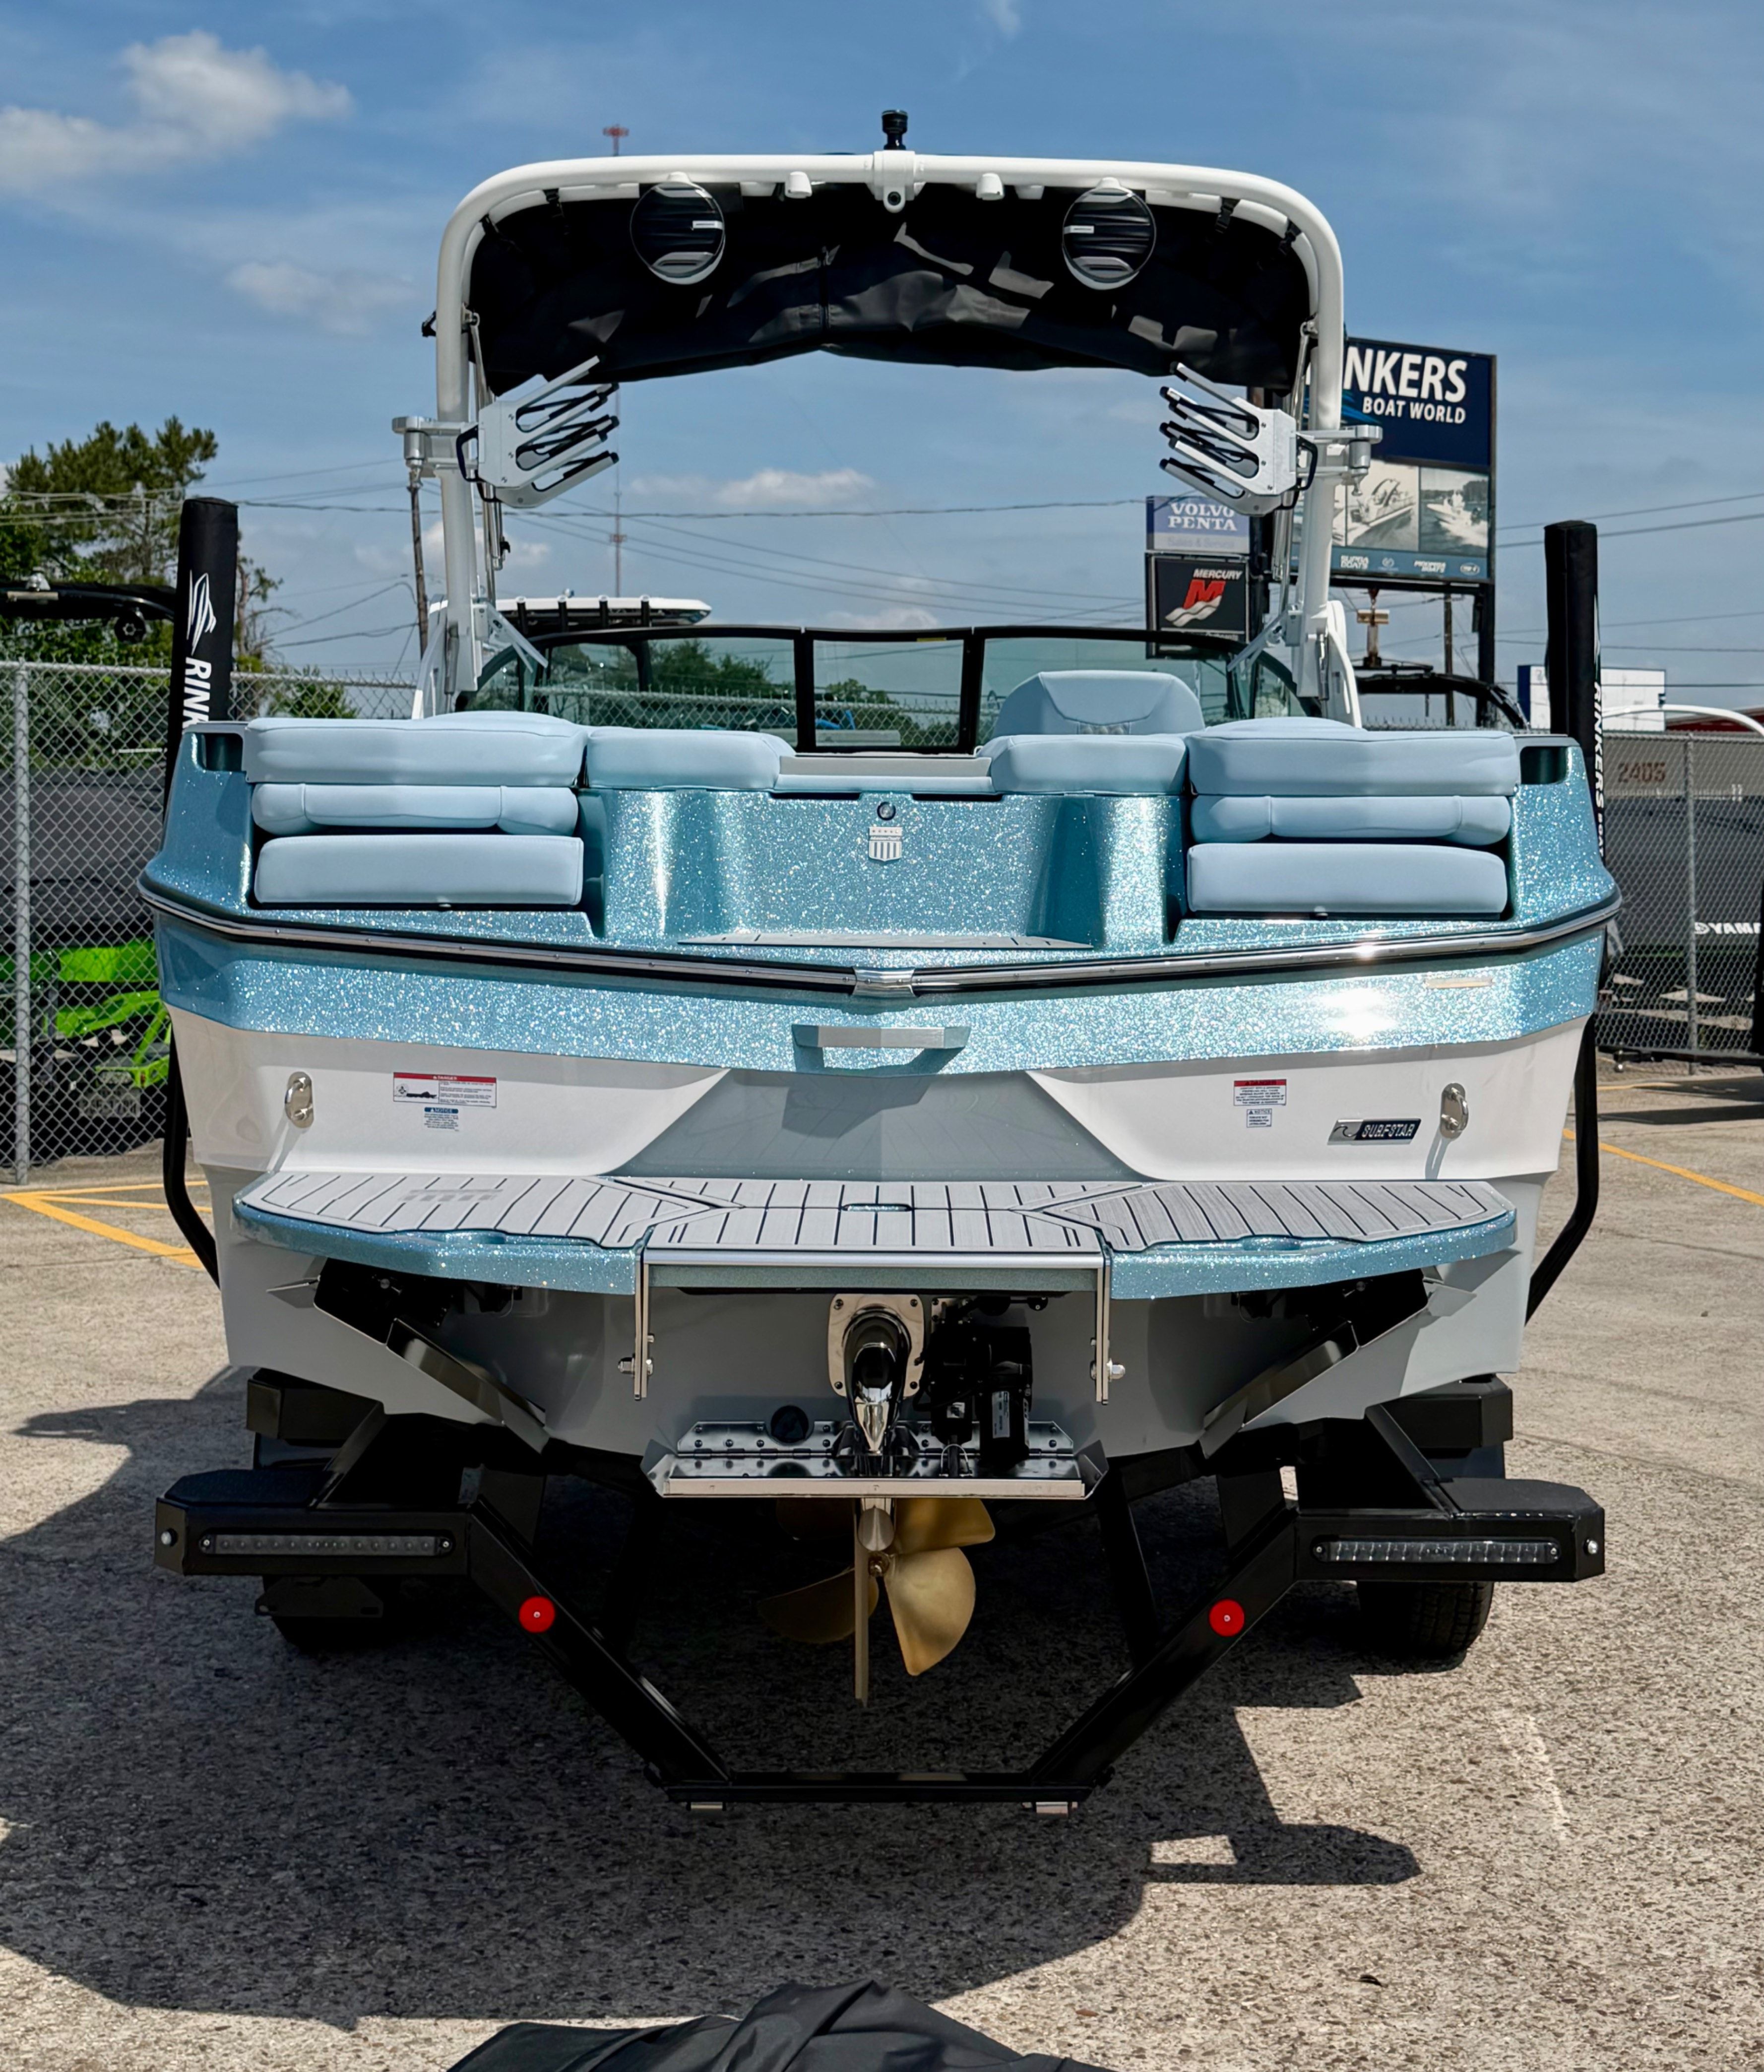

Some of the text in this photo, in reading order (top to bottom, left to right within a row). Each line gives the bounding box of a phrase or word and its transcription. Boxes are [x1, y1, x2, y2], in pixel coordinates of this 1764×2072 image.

[1343, 346, 1467, 403] NKERS
[1362, 396, 1466, 424] BOAT WORLD
[1170, 502, 1235, 517] VOLVO
[1168, 516, 1238, 531] PENTA
[1193, 568, 1243, 580] MERCURY
[1361, 1124, 1415, 1138] SURFSTAR
